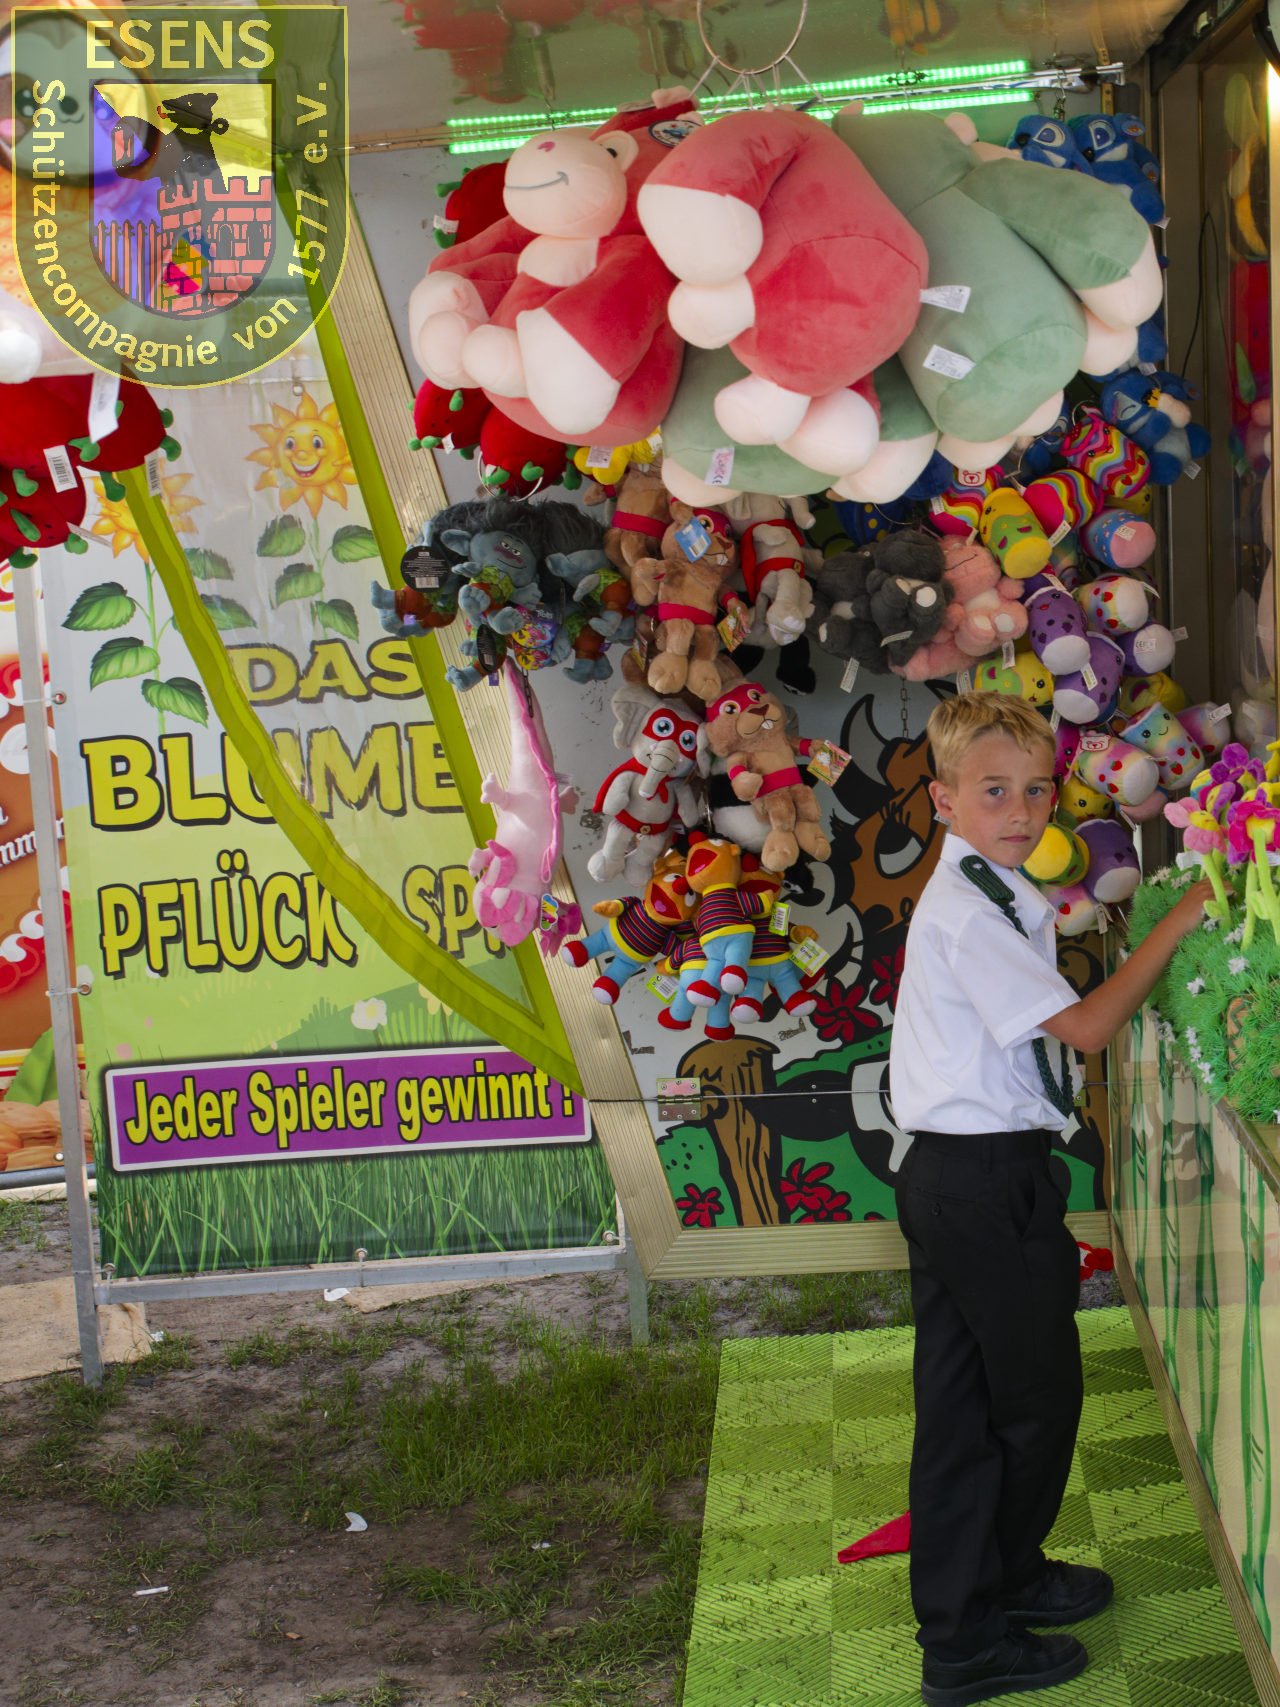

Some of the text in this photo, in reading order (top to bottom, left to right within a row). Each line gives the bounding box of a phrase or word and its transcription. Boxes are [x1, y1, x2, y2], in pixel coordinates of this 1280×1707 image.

[227, 638, 425, 706] DAS
[79, 721, 464, 832] BLUME
[98, 848, 358, 981] PFLÜCK
[124, 1077, 240, 1145] Jeder
[246, 1067, 386, 1151] Spieler
[395, 1058, 554, 1142] gewinnt
